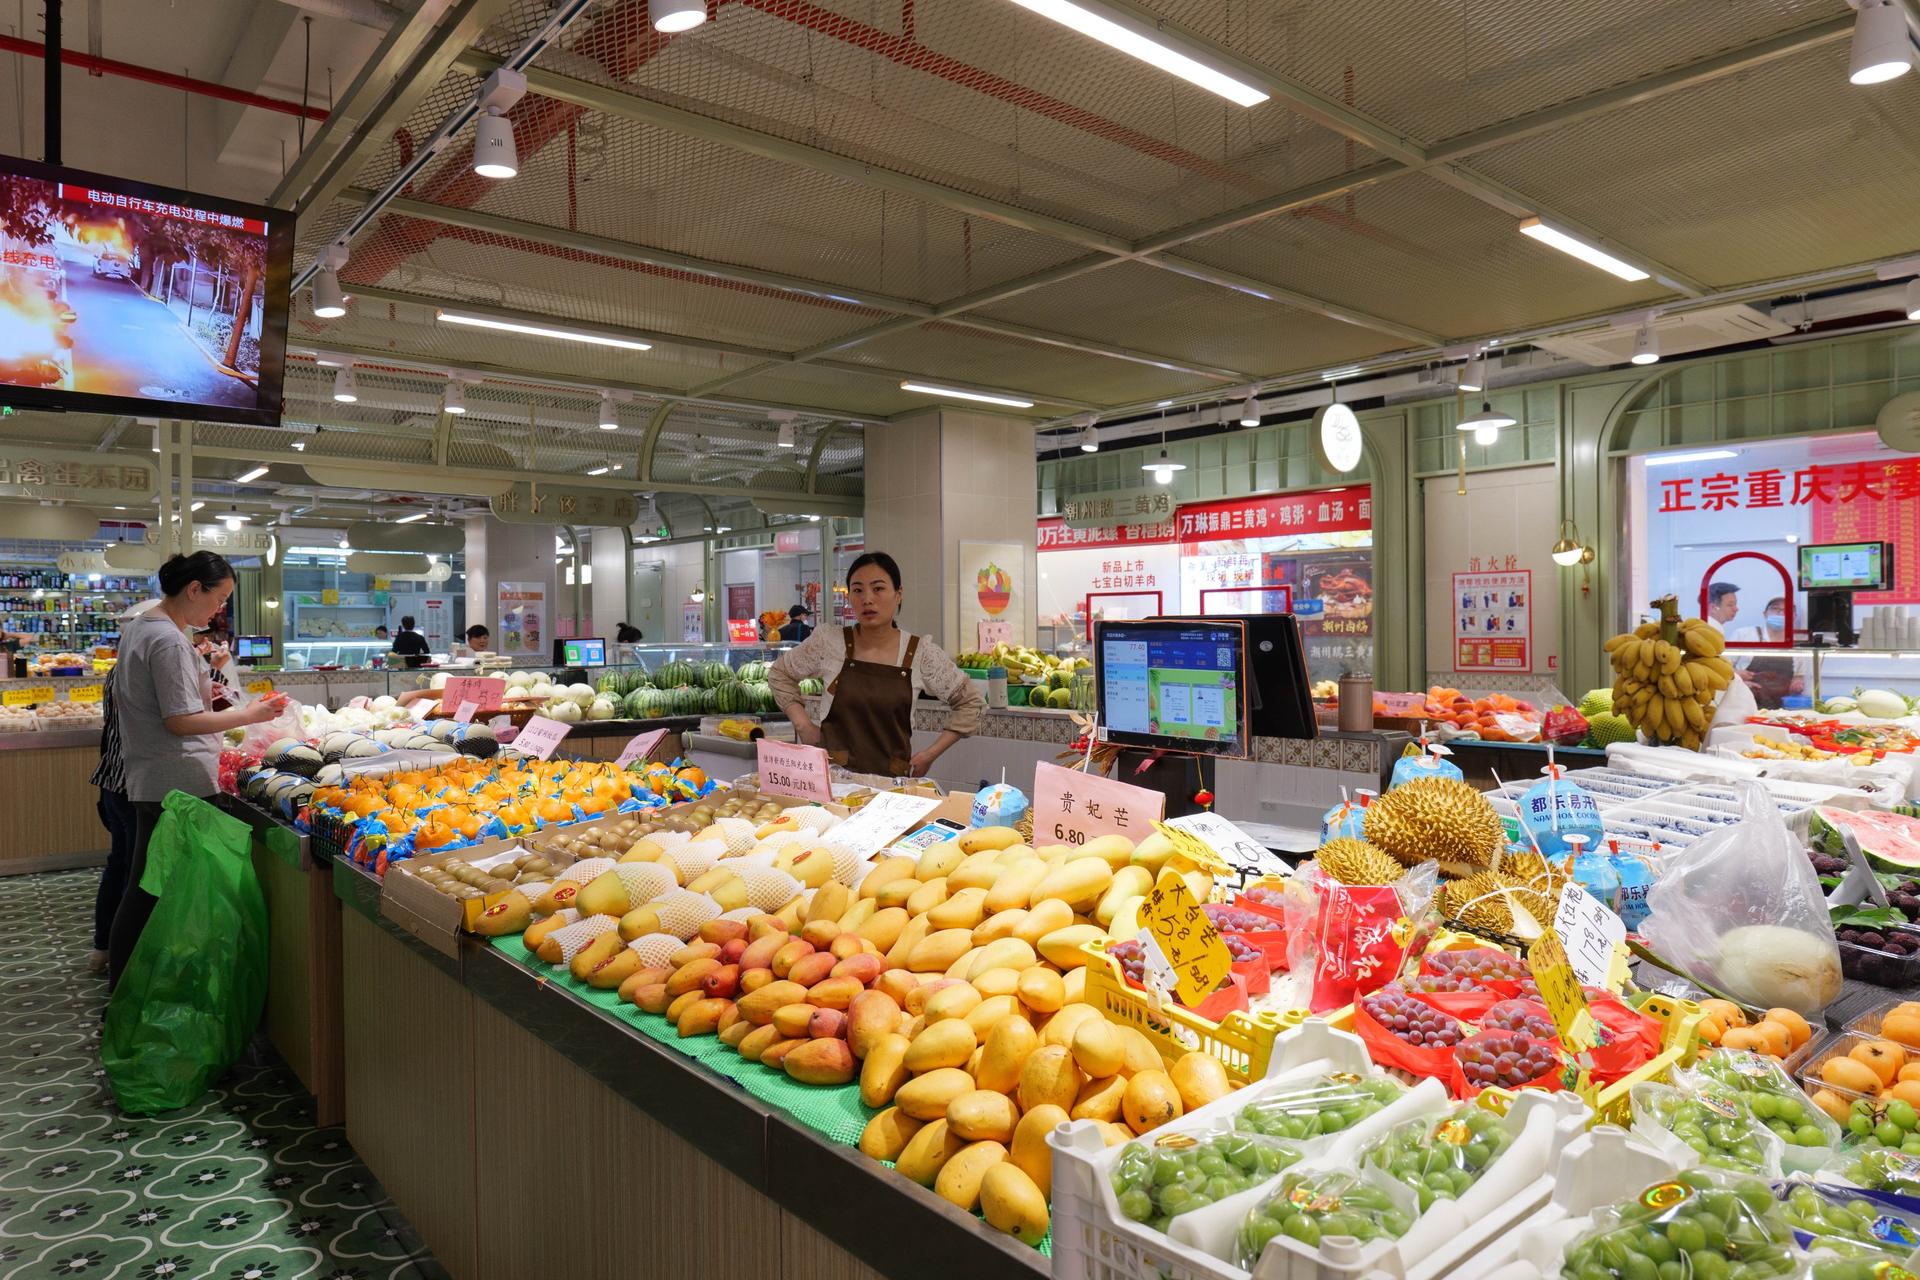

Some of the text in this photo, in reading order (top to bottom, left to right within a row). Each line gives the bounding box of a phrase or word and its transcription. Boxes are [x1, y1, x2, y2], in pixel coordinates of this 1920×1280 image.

[88, 189, 245, 229] 电动自行车充电过程中爆燃
[1102, 560, 1145, 574] 新品上市
[1469, 554, 1517, 572] 消火栓
[1092, 574, 1156, 589] 七宝白切羊肉
[768, 771, 791, 788] 15.00
[1060, 791, 1129, 828] 贵妃芒
[1054, 823, 1085, 846] 6.80
